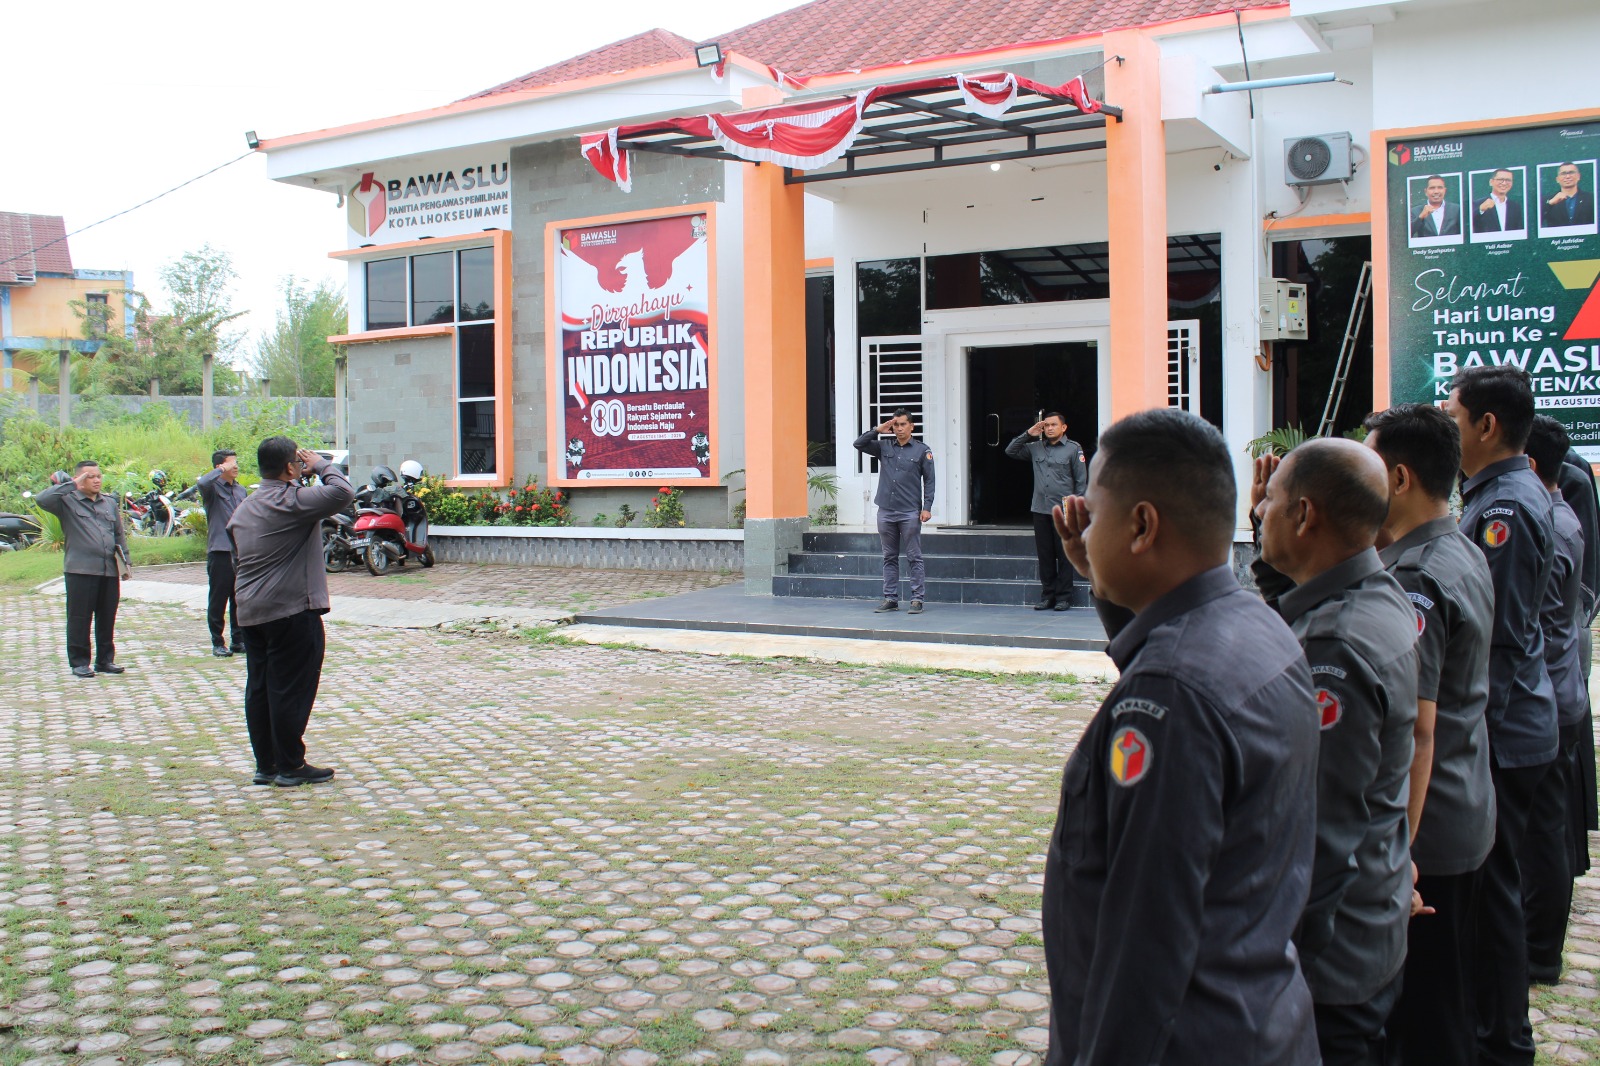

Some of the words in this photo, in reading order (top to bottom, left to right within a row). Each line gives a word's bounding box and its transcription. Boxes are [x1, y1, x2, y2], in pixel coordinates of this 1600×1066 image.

[1413, 142, 1463, 156] BAWASLU
[387, 162, 508, 201] BAWASLU
[388, 202, 419, 215] PANITIA
[420, 197, 464, 212] PENGAWAS
[464, 190, 508, 204] PEMILIHAN
[388, 214, 418, 229] KOTA
[420, 204, 509, 225] LHOKSEUMAWE
[580, 229, 617, 242] BAWASLU
[1411, 268, 1529, 312] Selamat
[591, 293, 684, 332] Dirgahayu
[1433, 306, 1479, 325] Hari
[1486, 304, 1555, 323] Ulang
[580, 323, 693, 350] REPUBLIK
[1433, 329, 1504, 346] Tahun
[1512, 326, 1542, 342] Ke
[567, 348, 708, 396] INDONESIA
[590, 399, 626, 437] 80
[626, 403, 652, 412] Bersatu
[653, 401, 685, 411] Berdaulat
[627, 413, 649, 423] Rakyat
[650, 411, 682, 422] Sejahtera
[627, 422, 658, 431] Indonesia
[659, 421, 675, 432] Maju
[1111, 699, 1163, 718] BAWASLU
